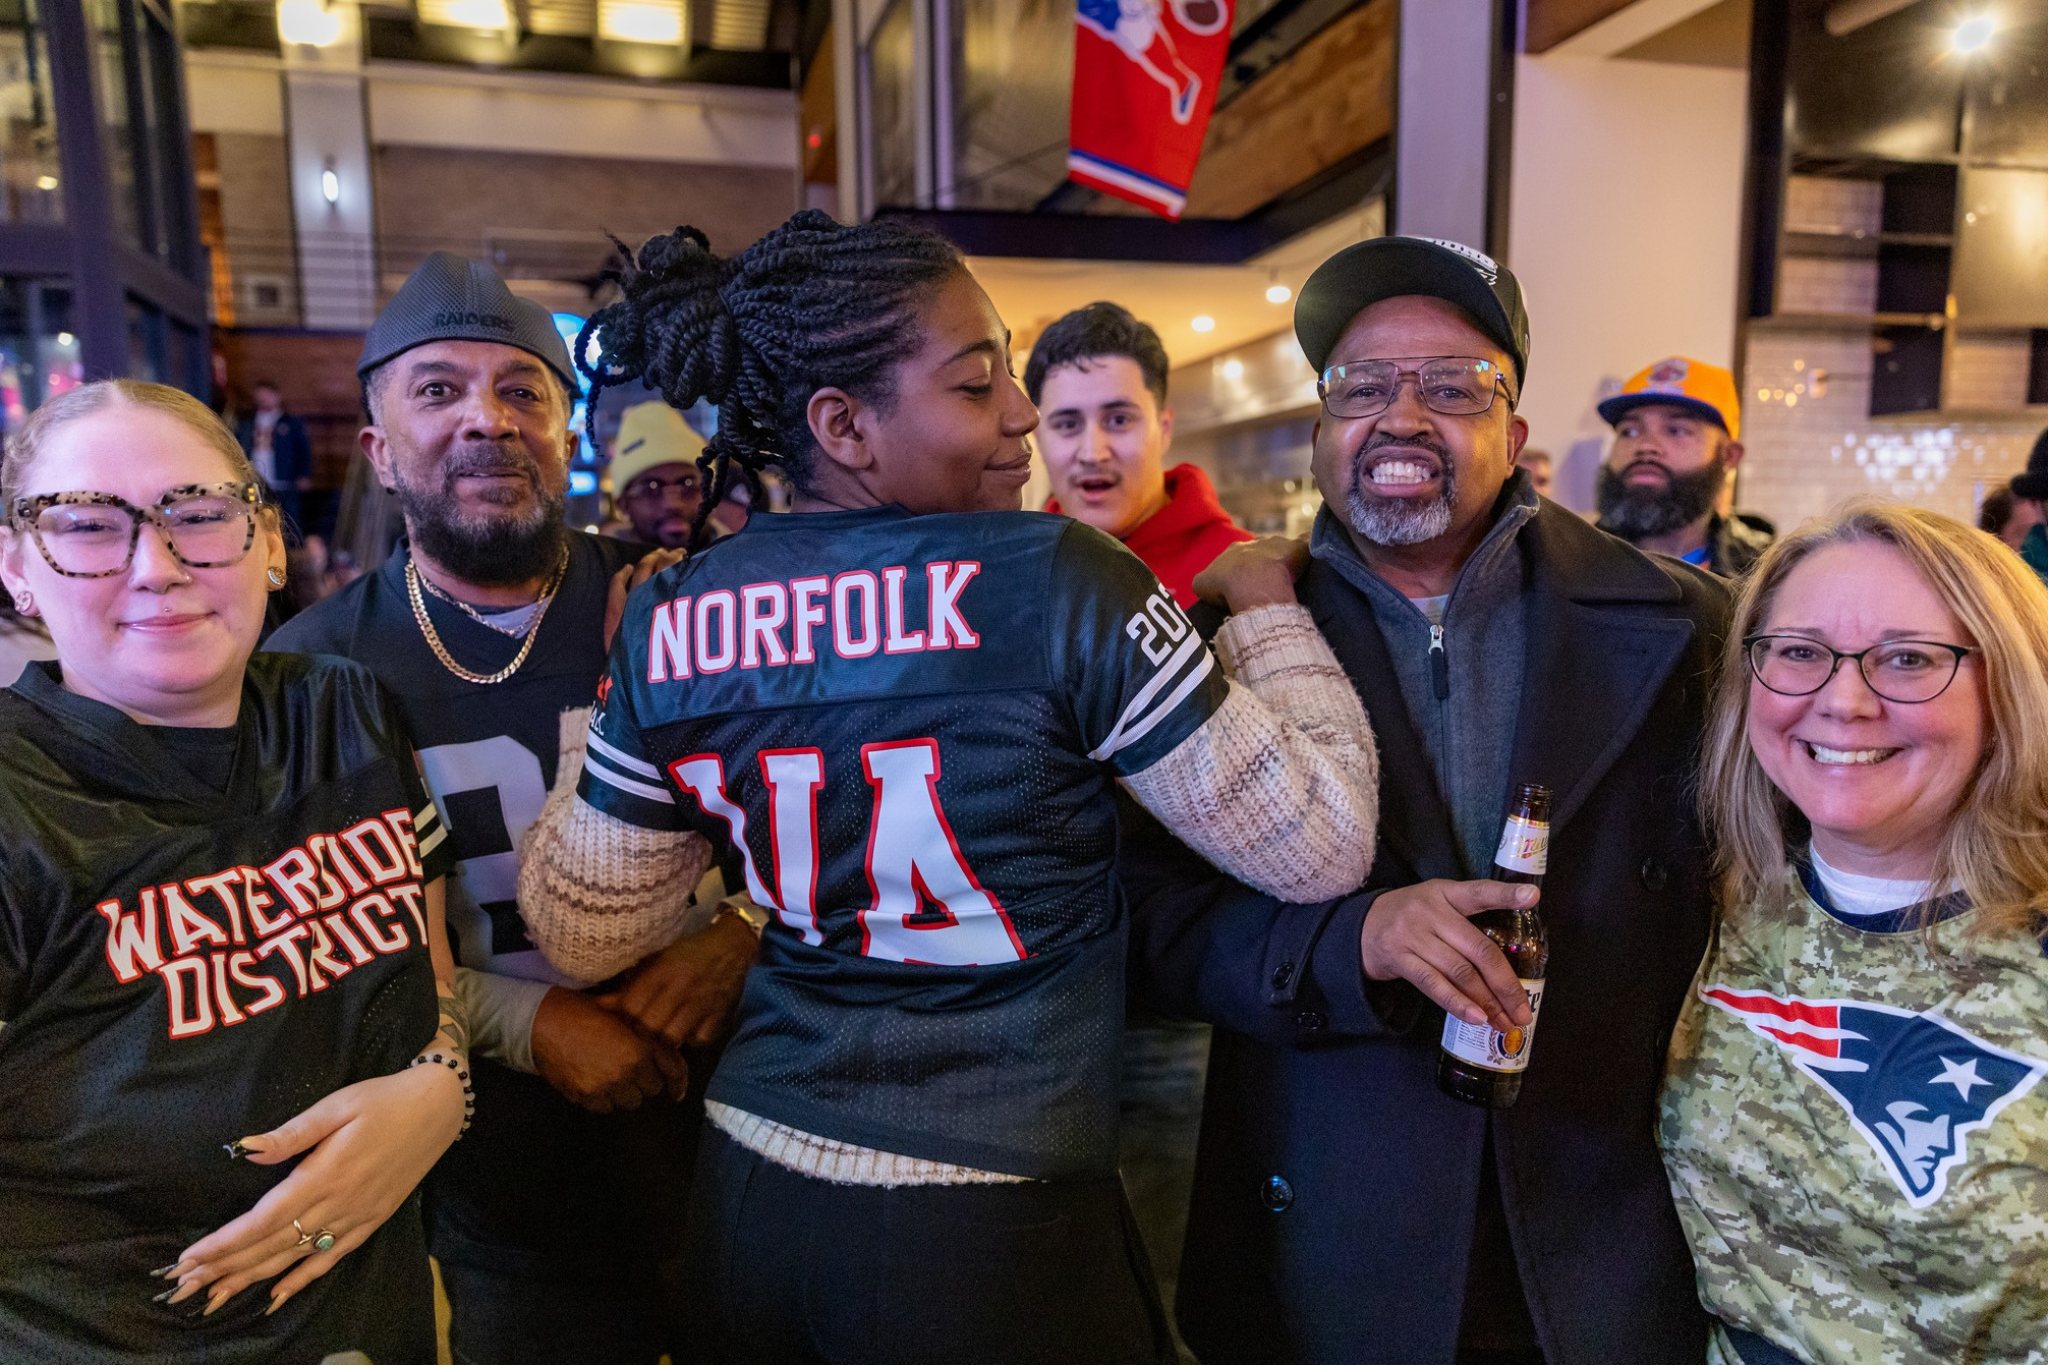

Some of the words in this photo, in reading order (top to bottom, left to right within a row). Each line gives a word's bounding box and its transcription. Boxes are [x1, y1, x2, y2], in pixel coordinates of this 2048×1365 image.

[648, 560, 981, 683] NORFOLK
[96, 807, 424, 984] WATERSIDE
[668, 737, 1030, 966] VA
[157, 883, 428, 1039] DISTRICT
